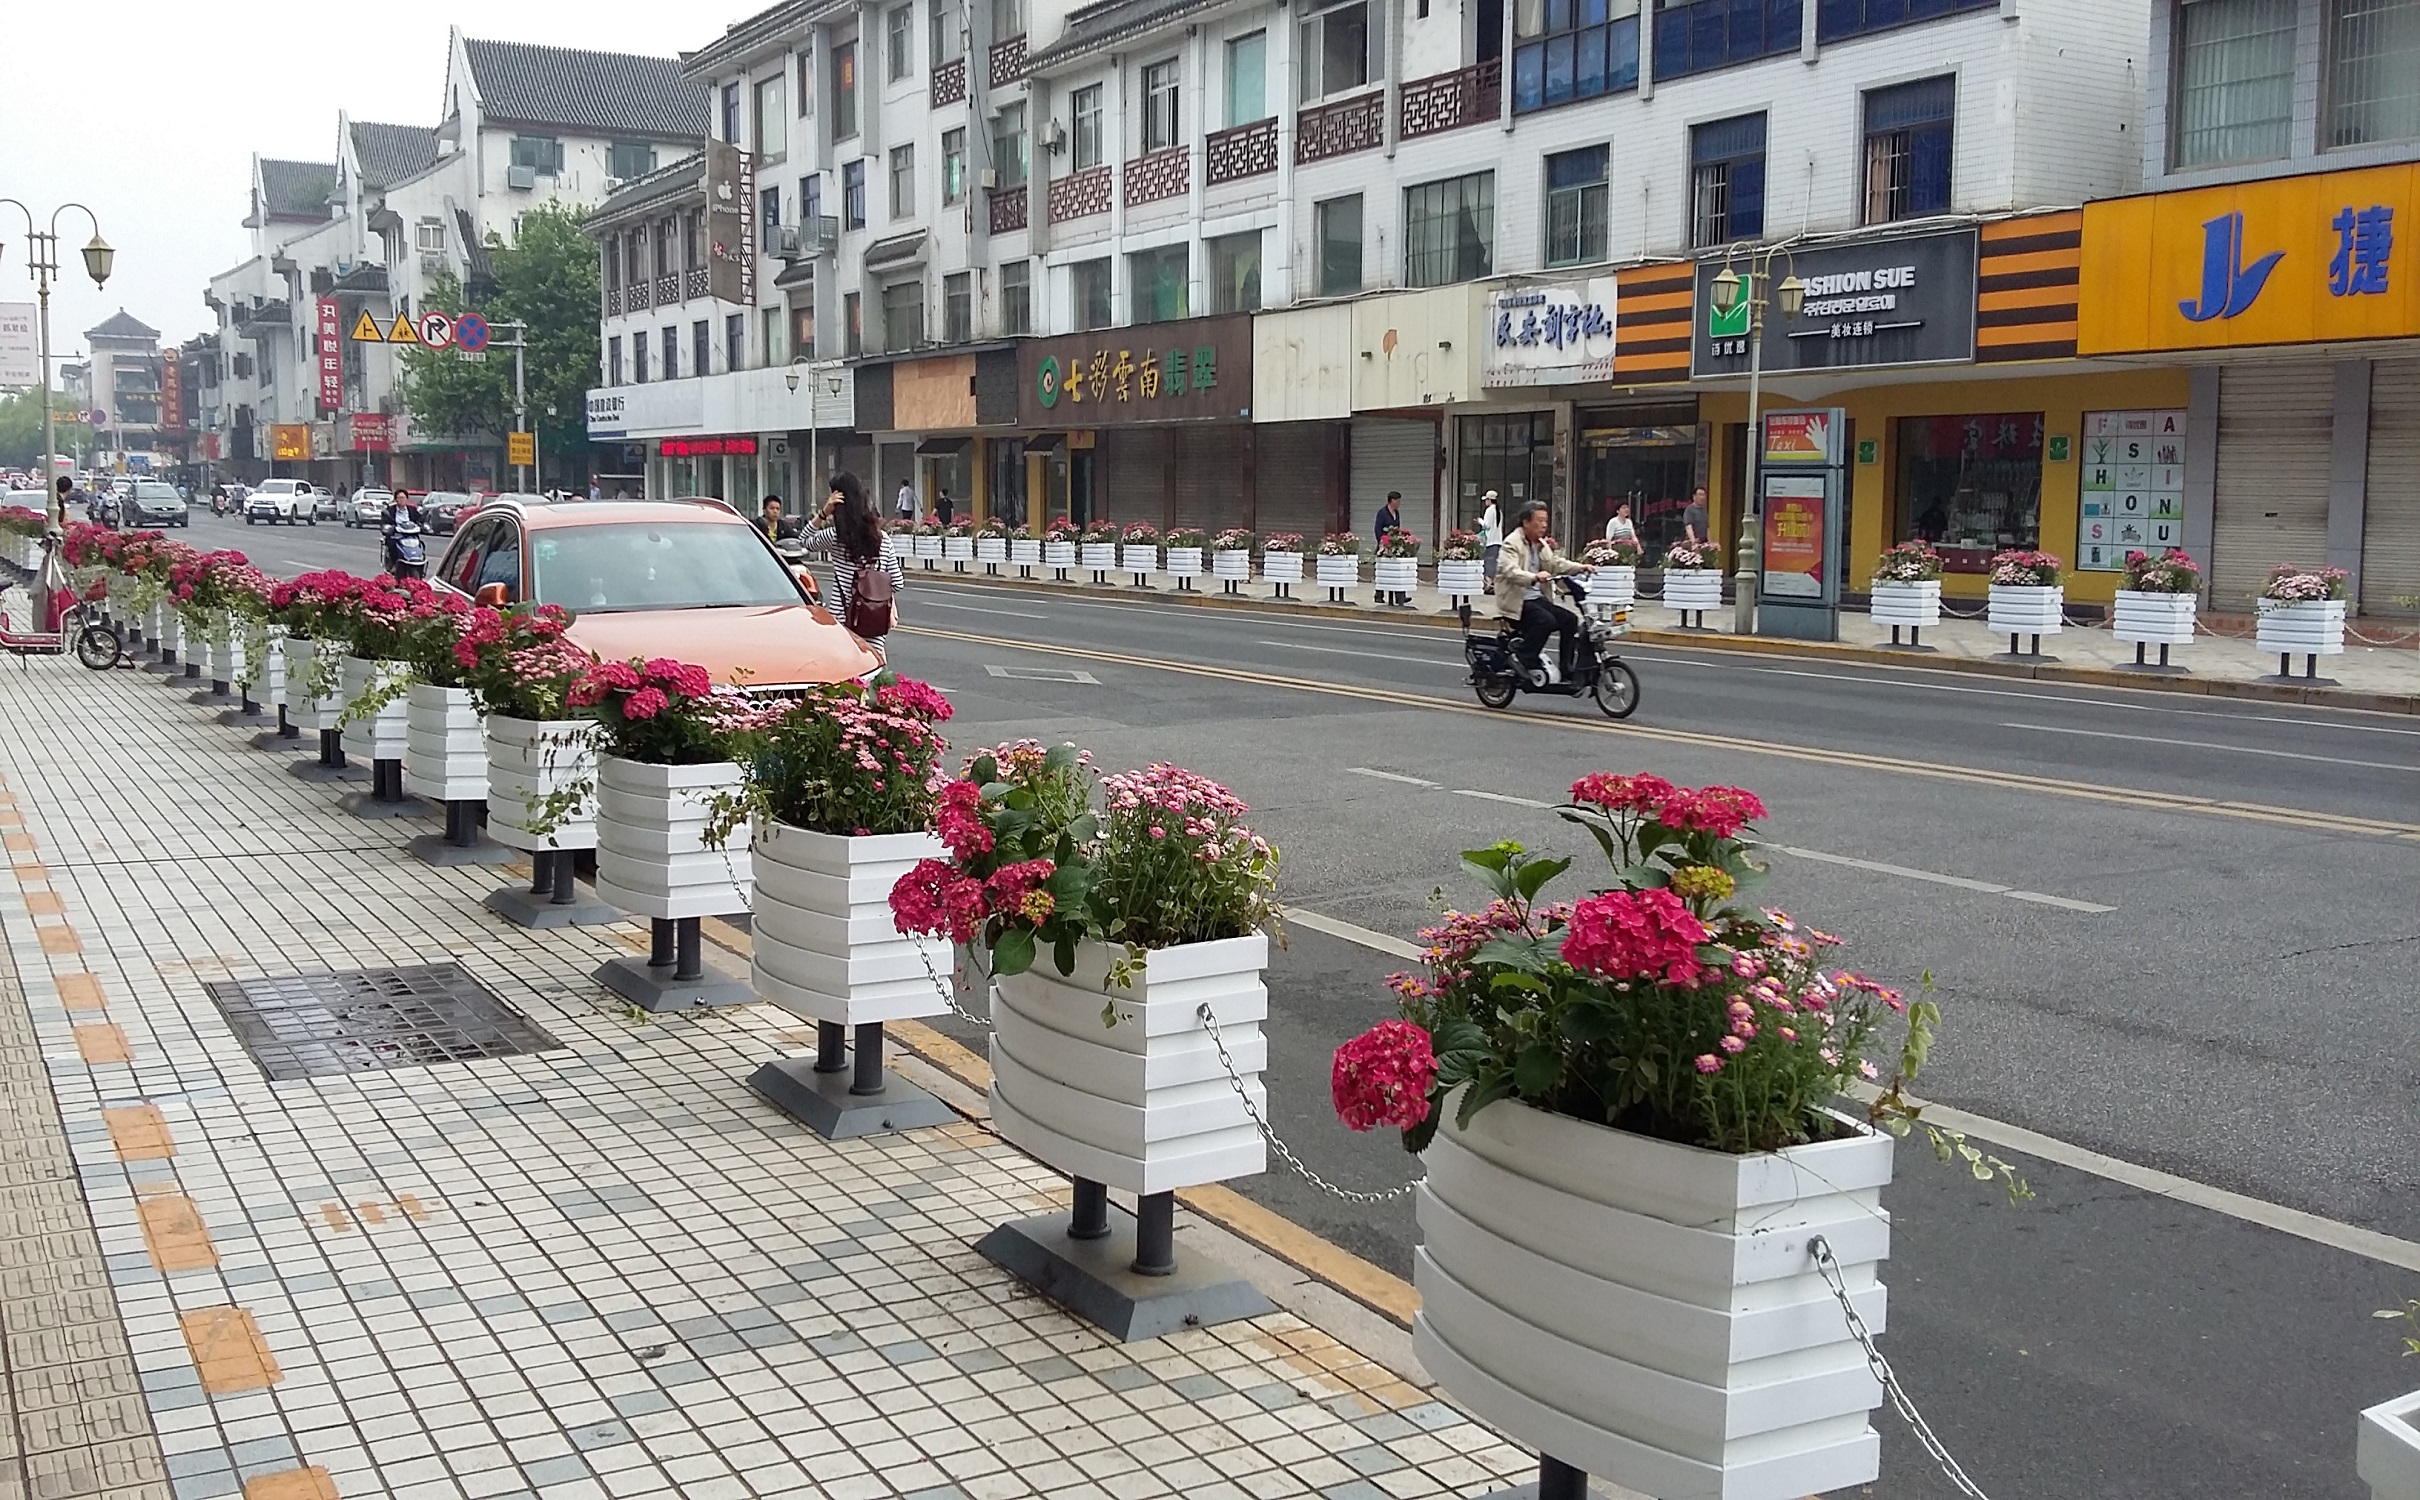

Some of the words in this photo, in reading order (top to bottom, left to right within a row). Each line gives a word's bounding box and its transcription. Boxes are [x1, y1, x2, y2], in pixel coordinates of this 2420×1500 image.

[712, 203, 739, 214] iPhone
[2328, 205, 2394, 297] 捷
[1873, 265, 1916, 290] SUE
[1830, 320, 1874, 339] 美妆连锁
[2098, 418, 2108, 434] F
[2163, 416, 2176, 433] A
[1769, 435, 1797, 451] Taxi
[2128, 442, 2140, 459] S
[2095, 469, 2107, 485] H
[2164, 469, 2171, 485] I
[2125, 495, 2137, 511] O
[2159, 498, 2172, 515] N
[2091, 523, 2103, 540] S
[2158, 525, 2169, 541] U
